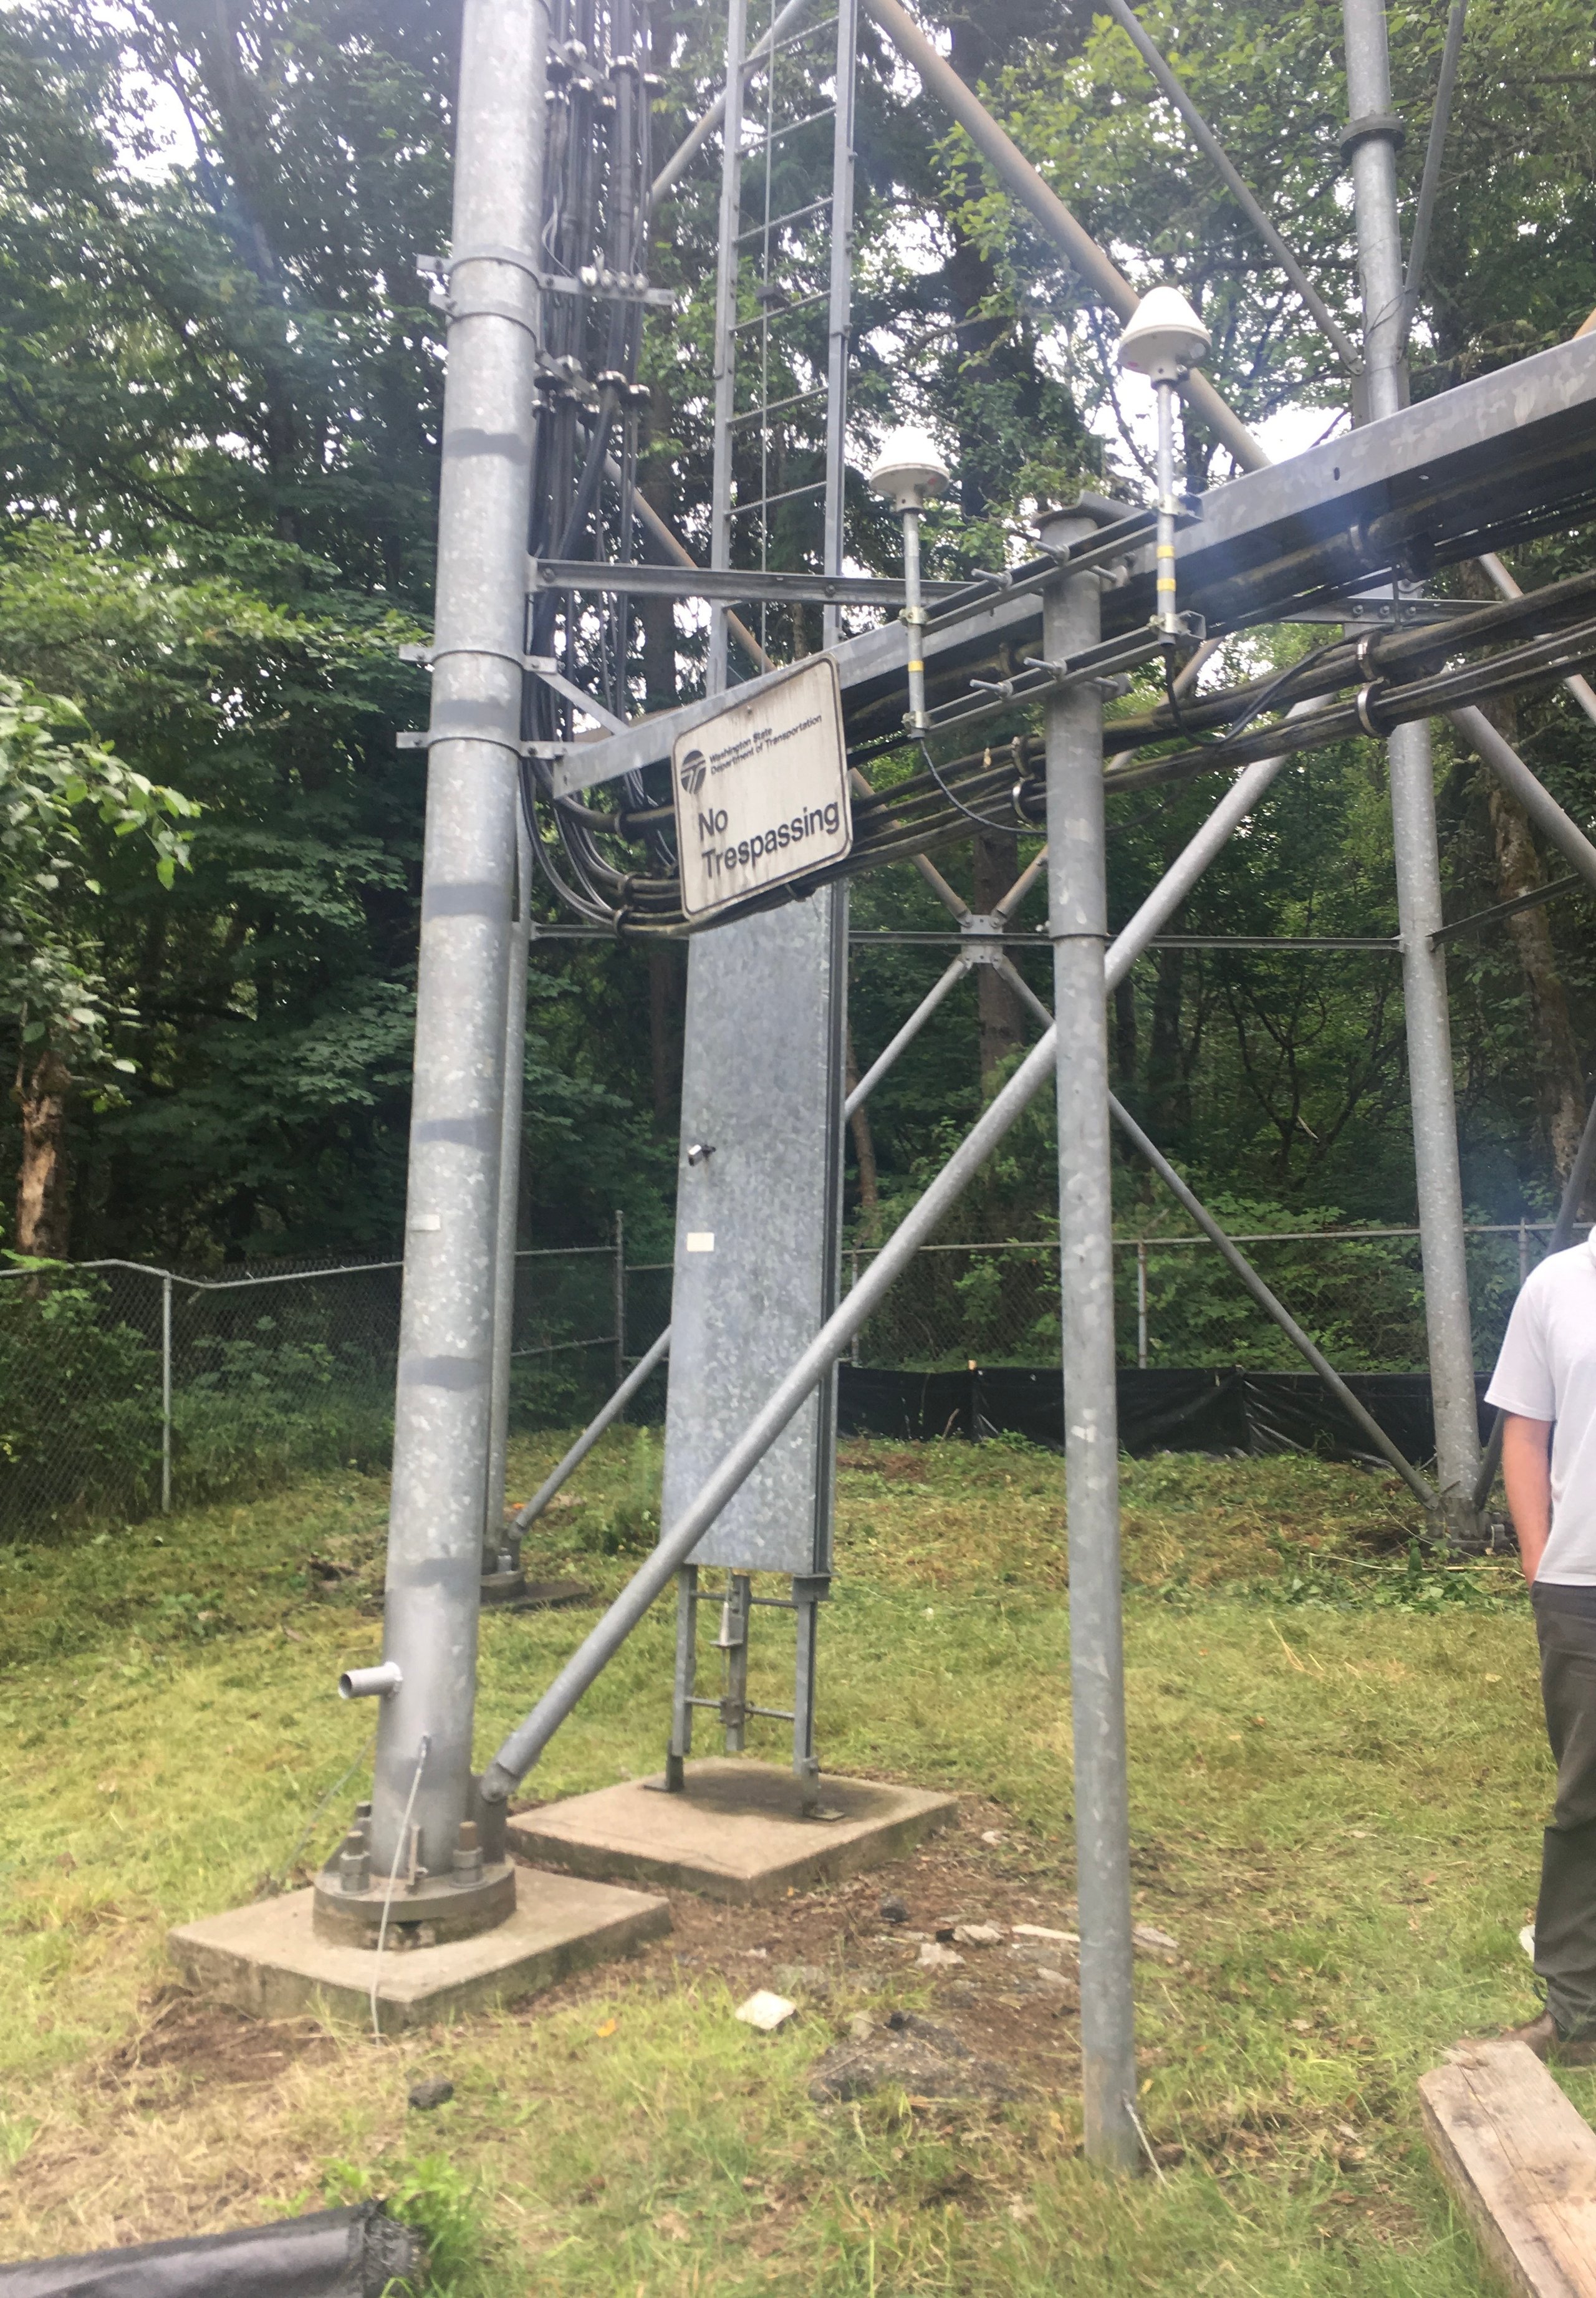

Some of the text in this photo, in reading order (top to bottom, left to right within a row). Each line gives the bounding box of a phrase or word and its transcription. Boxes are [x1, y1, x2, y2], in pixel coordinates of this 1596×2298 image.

[709, 728, 772, 762] Washington State
[711, 715, 822, 774] Department of Transportation
[698, 808, 728, 840] No
[702, 802, 840, 878] Trespassing
